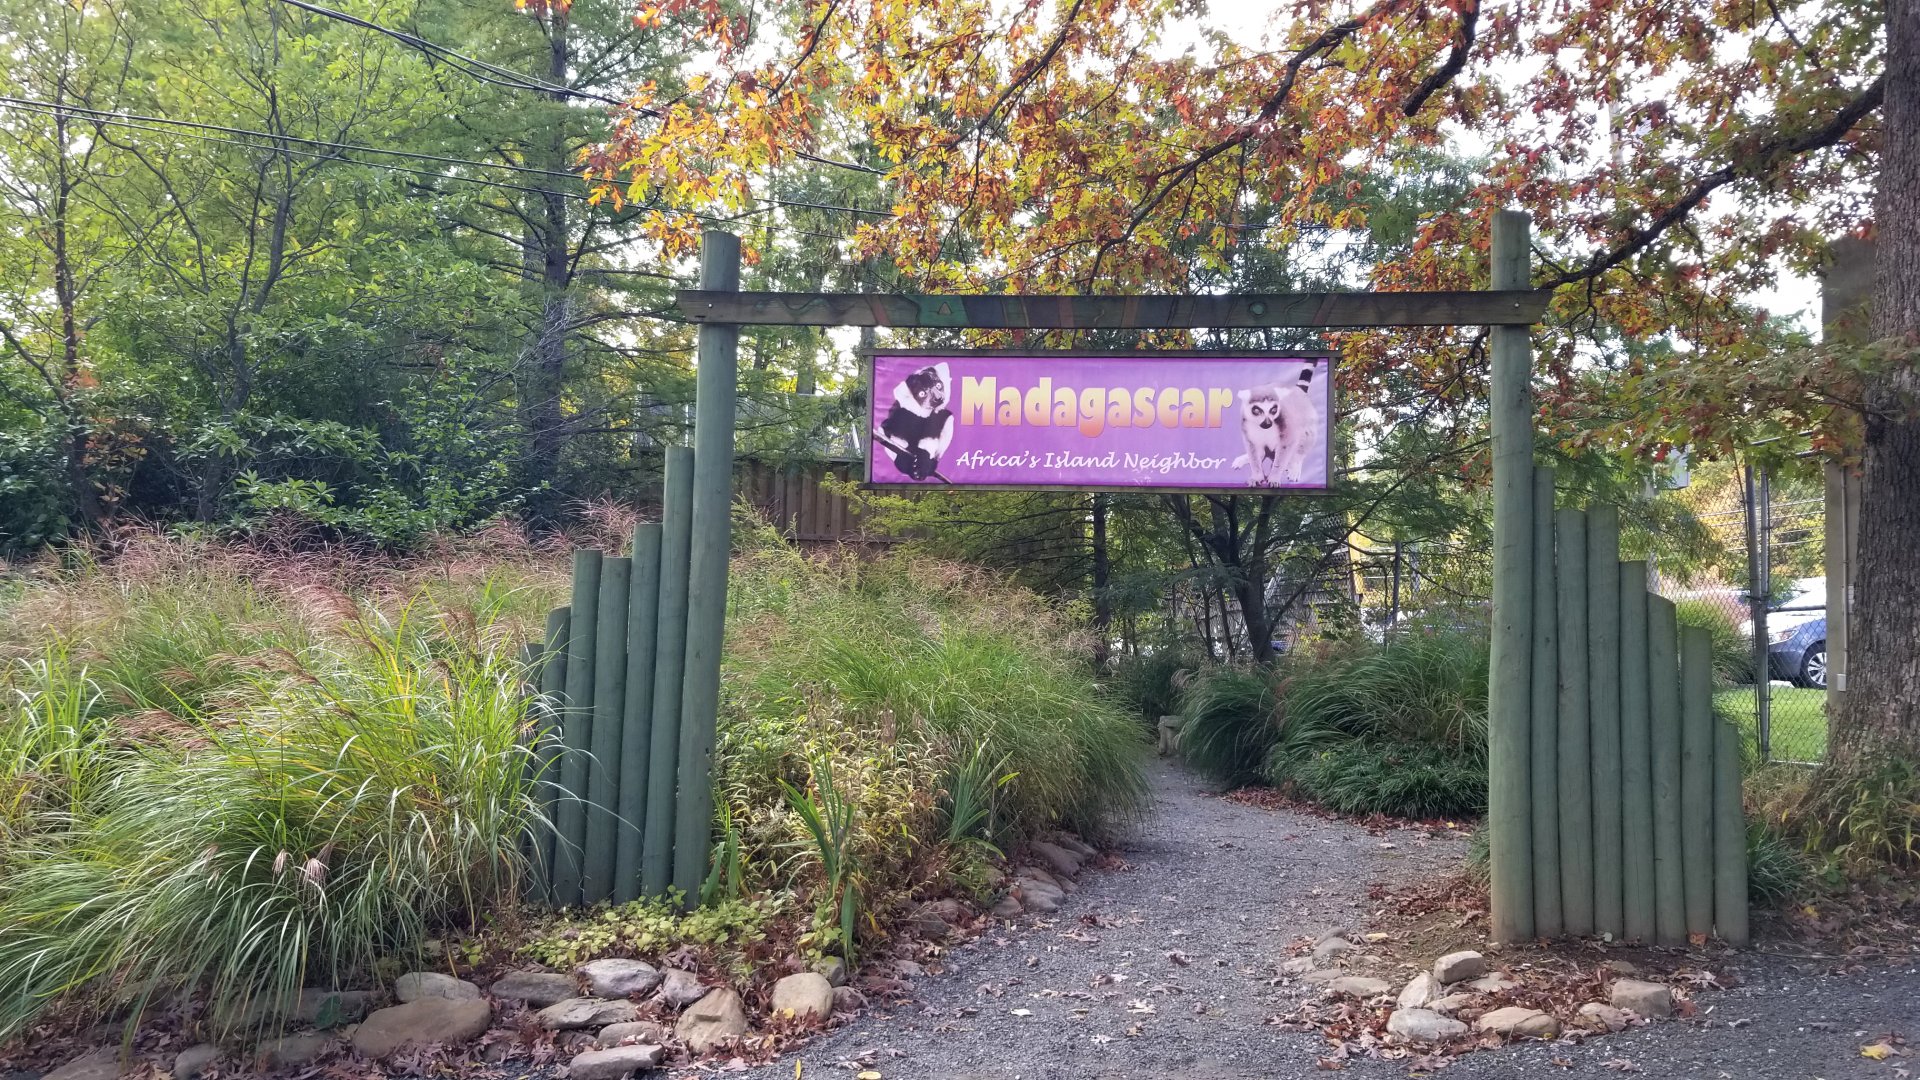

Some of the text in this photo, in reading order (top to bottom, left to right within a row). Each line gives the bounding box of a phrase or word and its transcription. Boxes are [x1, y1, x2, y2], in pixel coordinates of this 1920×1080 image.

[960, 376, 1233, 437] Madagascar
[956, 450, 1226, 474] Africa's Island Neighbor
